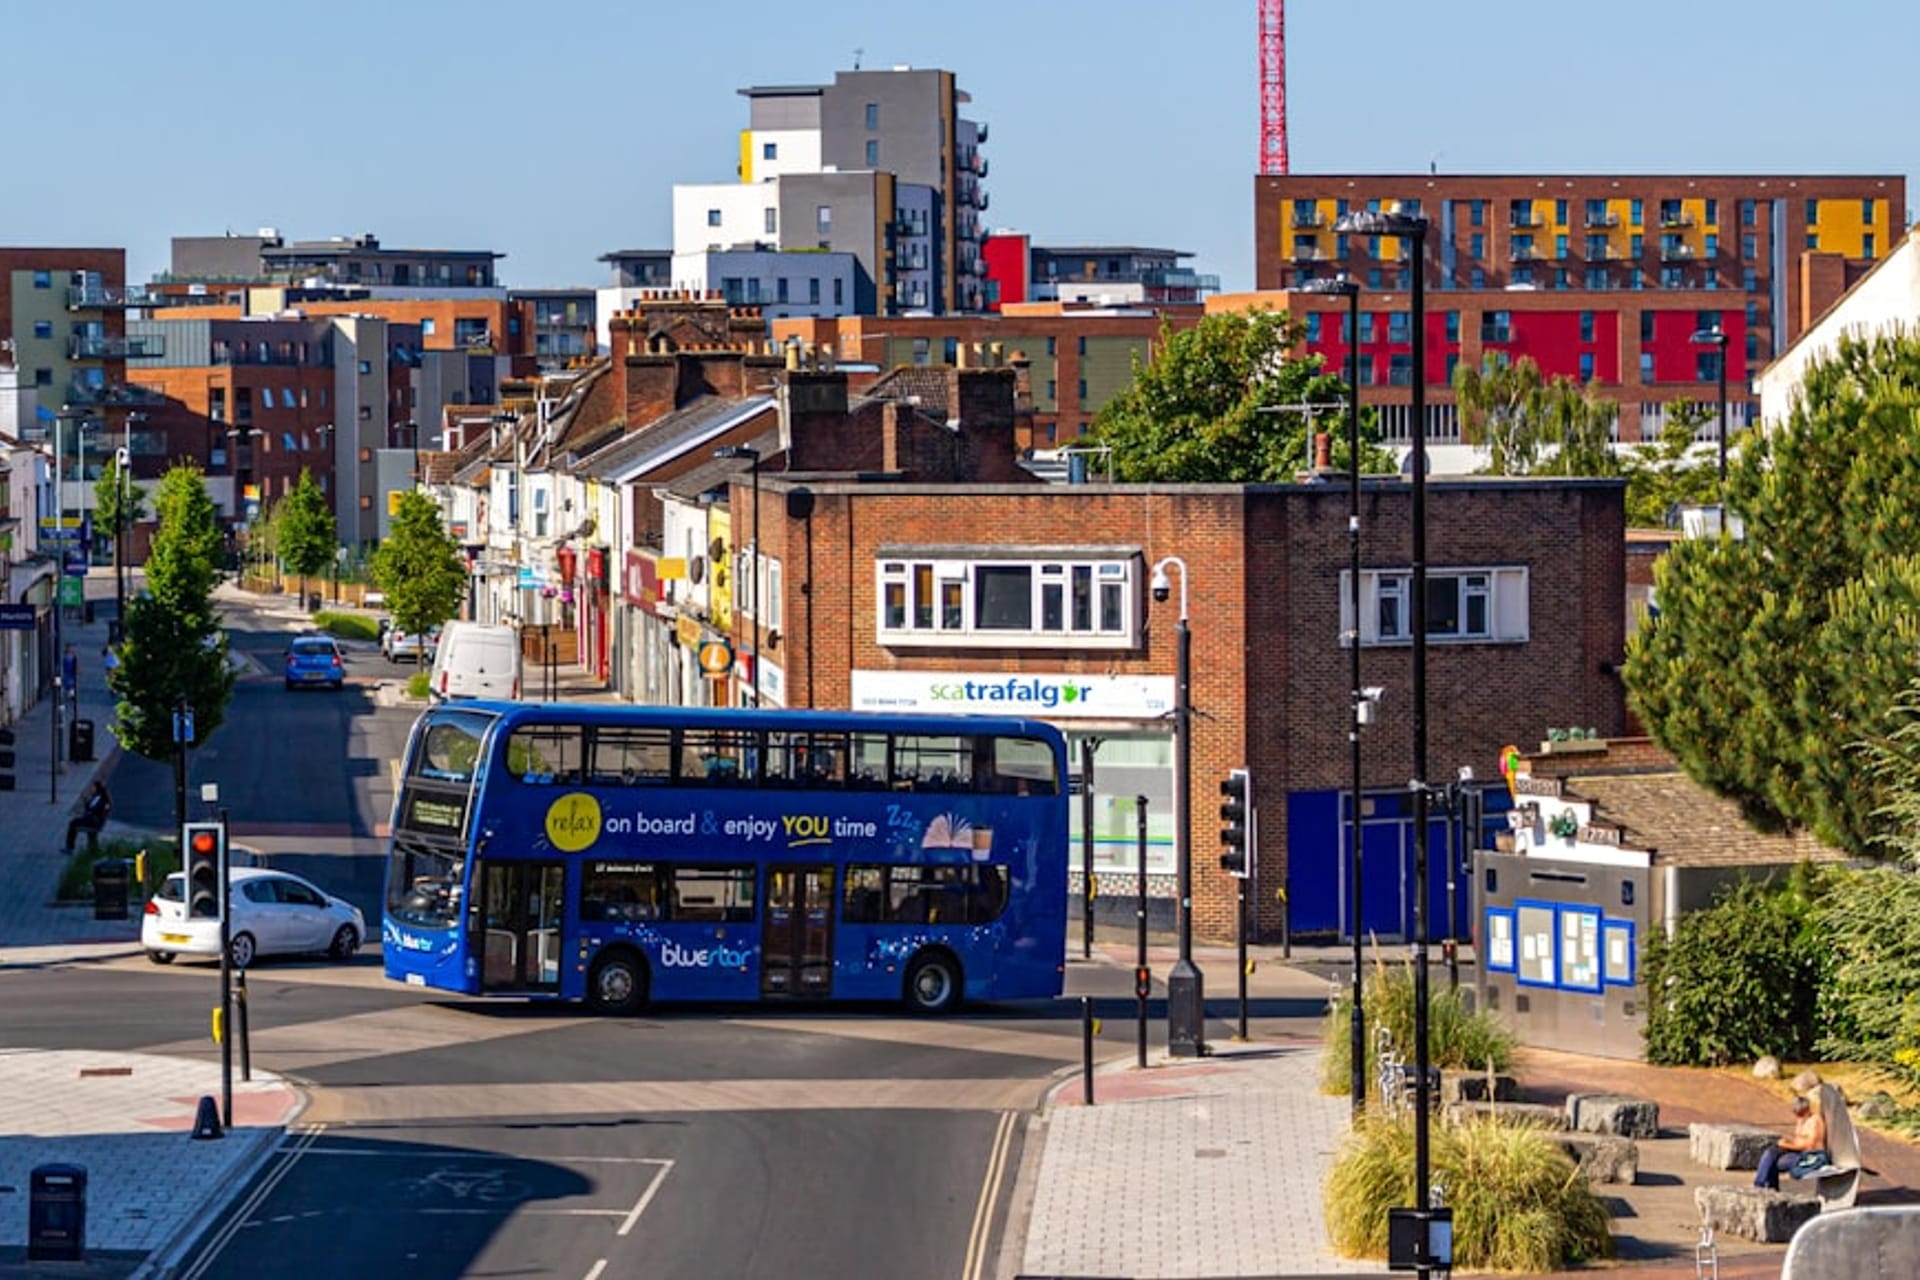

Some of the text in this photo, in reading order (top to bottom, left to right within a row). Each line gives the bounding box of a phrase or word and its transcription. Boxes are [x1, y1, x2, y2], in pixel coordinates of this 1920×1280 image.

[553, 800, 594, 838] relax
[606, 810, 877, 841] on board & enjoy YOU time
[662, 944, 752, 967] bluestar
